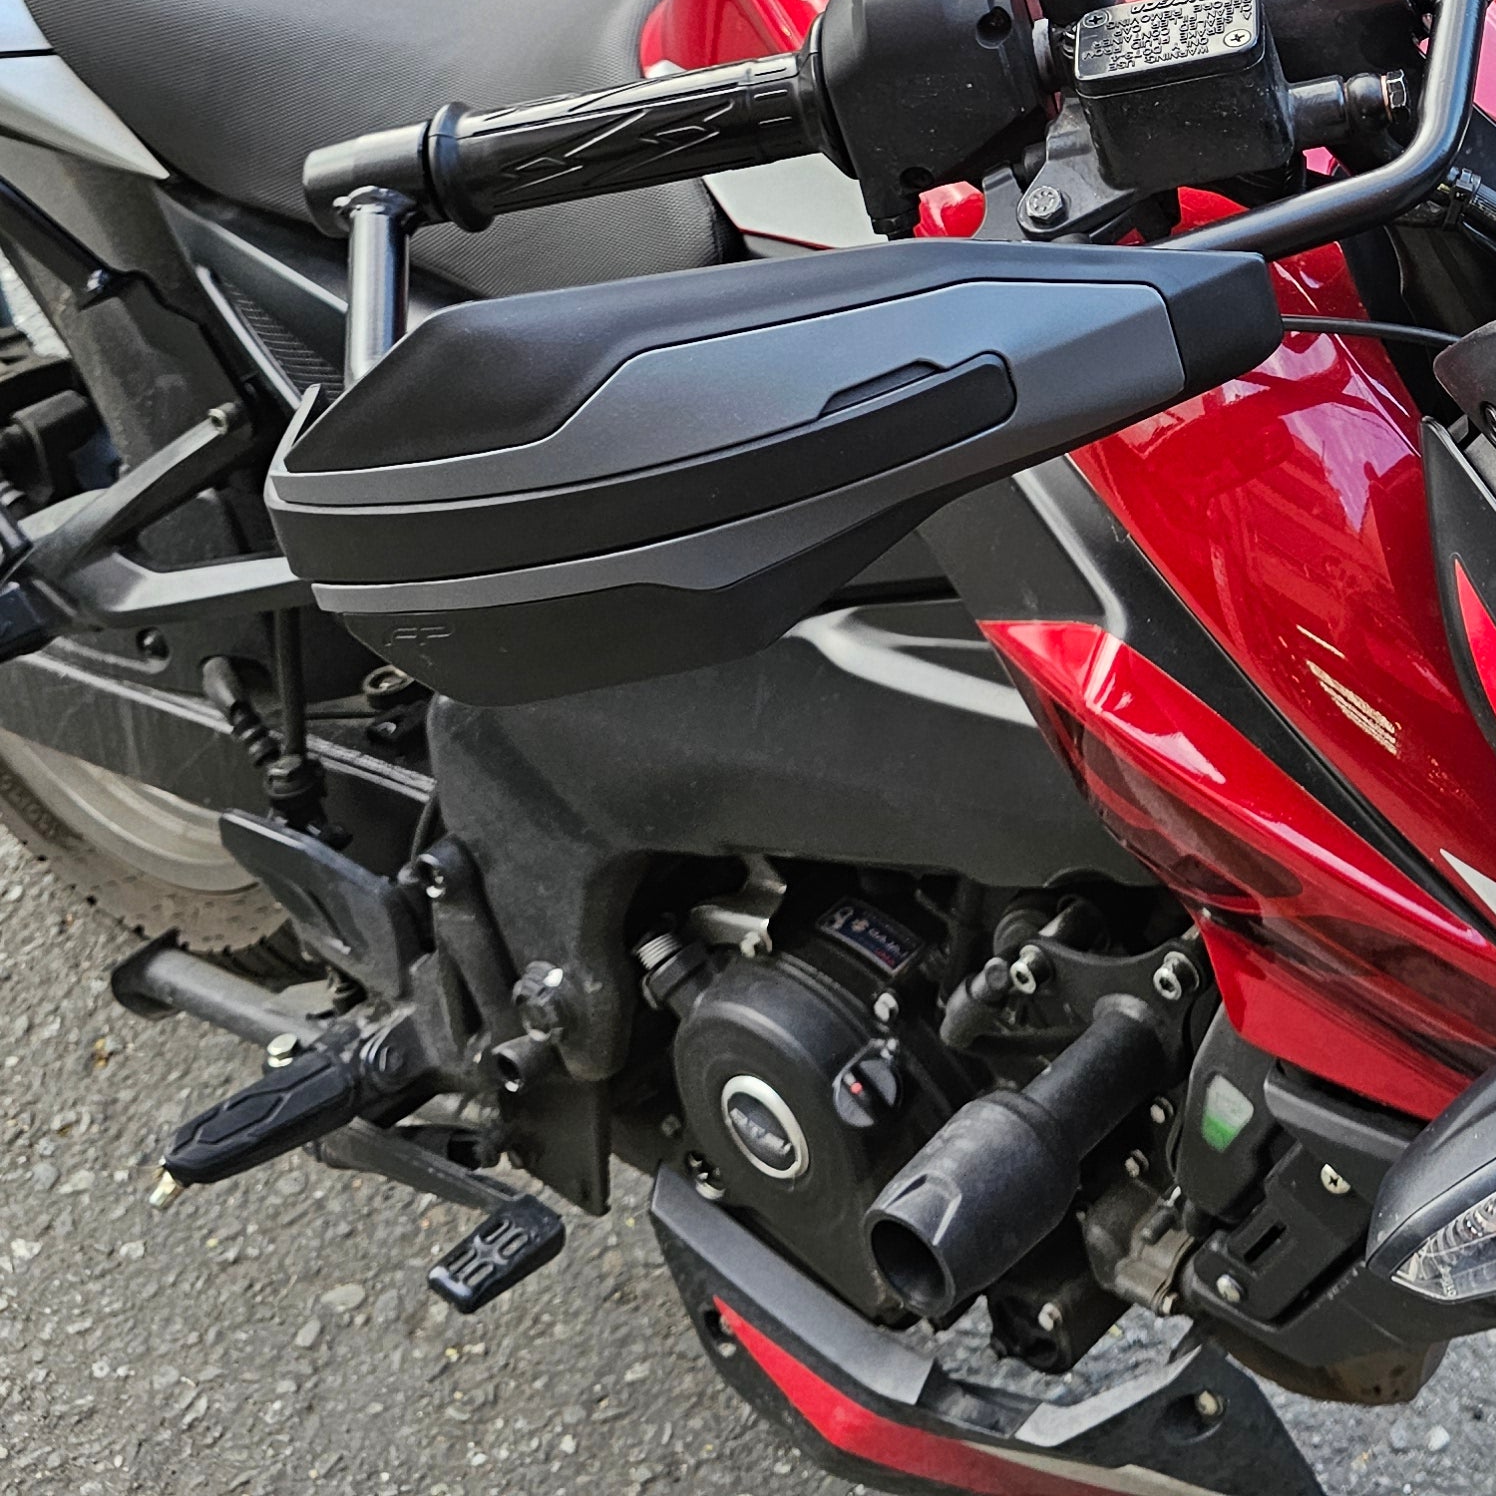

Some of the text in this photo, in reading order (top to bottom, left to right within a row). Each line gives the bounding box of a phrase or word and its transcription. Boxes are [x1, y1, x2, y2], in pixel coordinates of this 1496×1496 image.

[1093, 12, 1253, 49] A SEALED CONTAINER
[1106, 8, 1182, 30] REMOVING
[1113, 5, 1252, 37] CLEAN FILLER CAP
[1131, 36, 1170, 50] FLUID
[1180, 25, 1225, 42] BRAKE
[1108, 46, 1209, 72] WARNING USE
